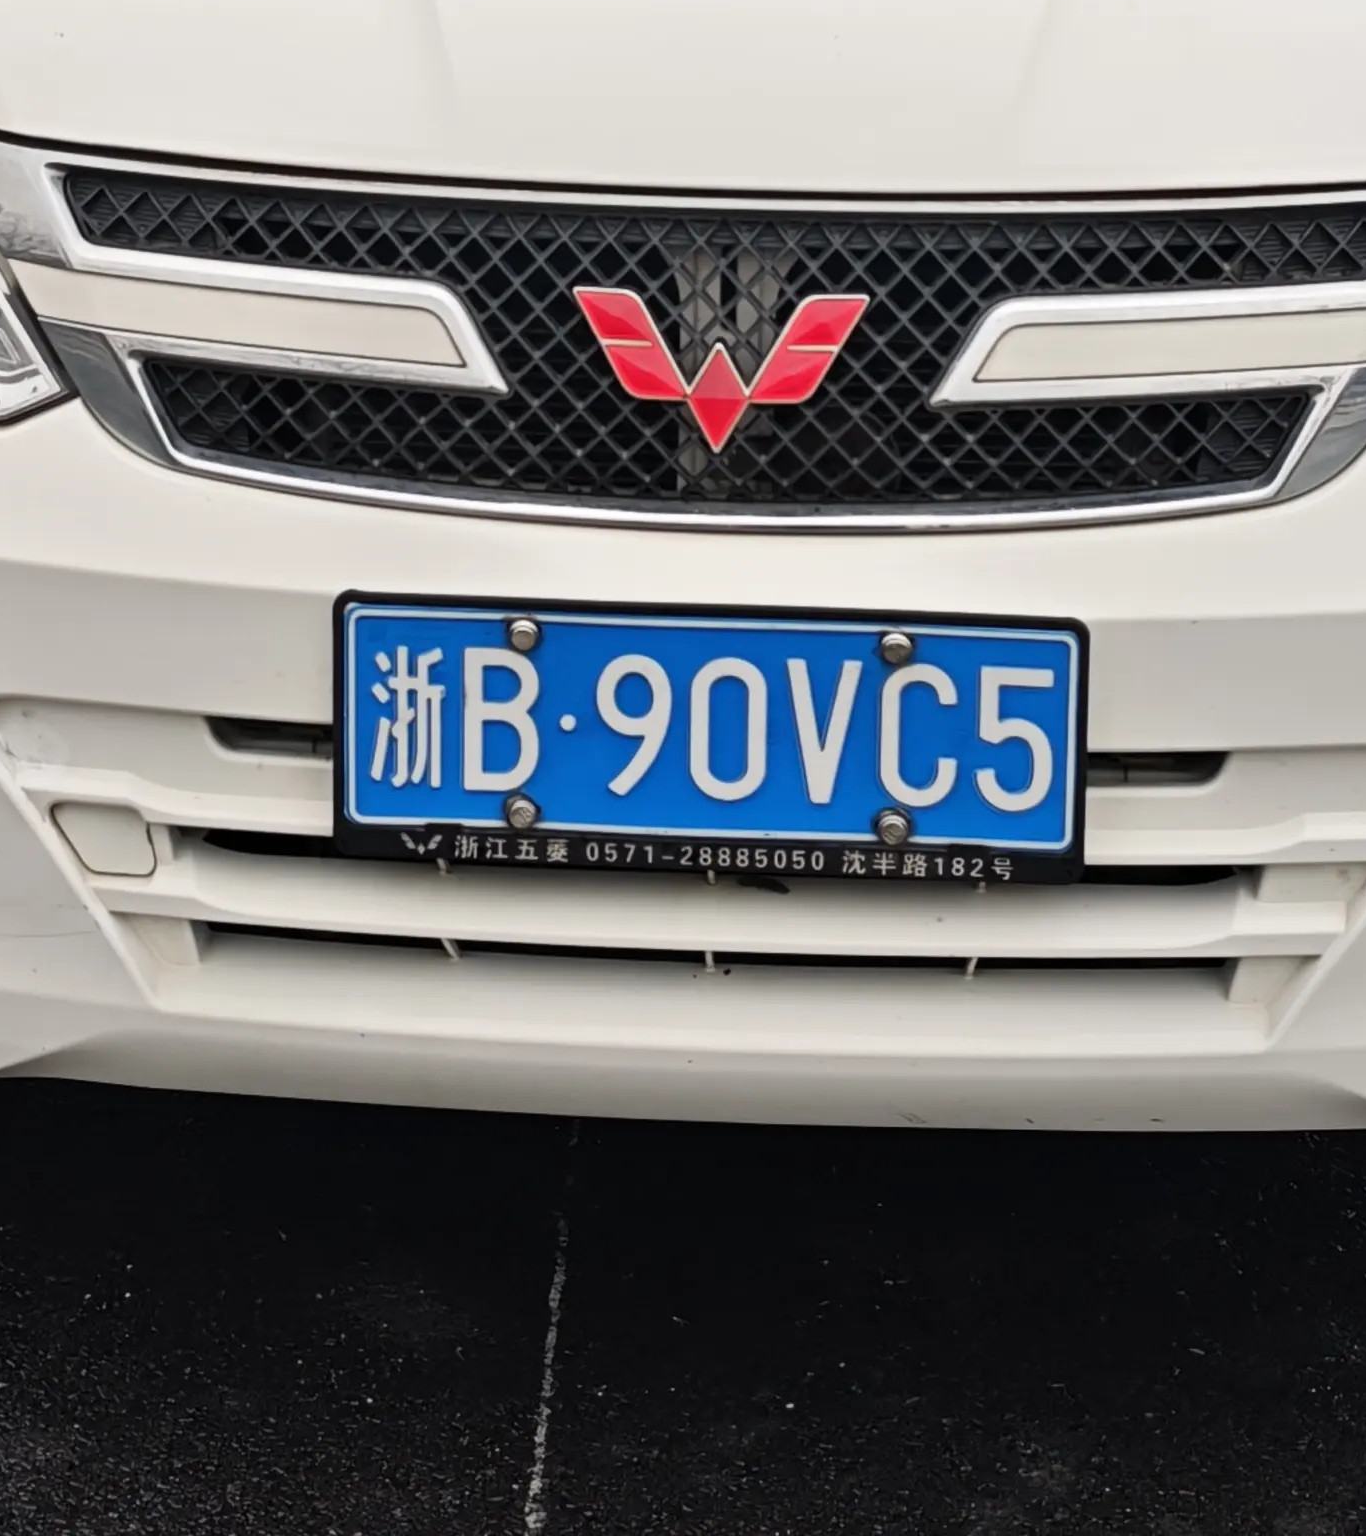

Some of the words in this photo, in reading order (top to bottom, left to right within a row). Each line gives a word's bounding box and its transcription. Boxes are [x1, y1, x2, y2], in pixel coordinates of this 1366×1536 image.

[369, 644, 1056, 813] 浙B·90VC5
[454, 834, 570, 863] 浙江五菱
[585, 841, 825, 872] 0571-28885050
